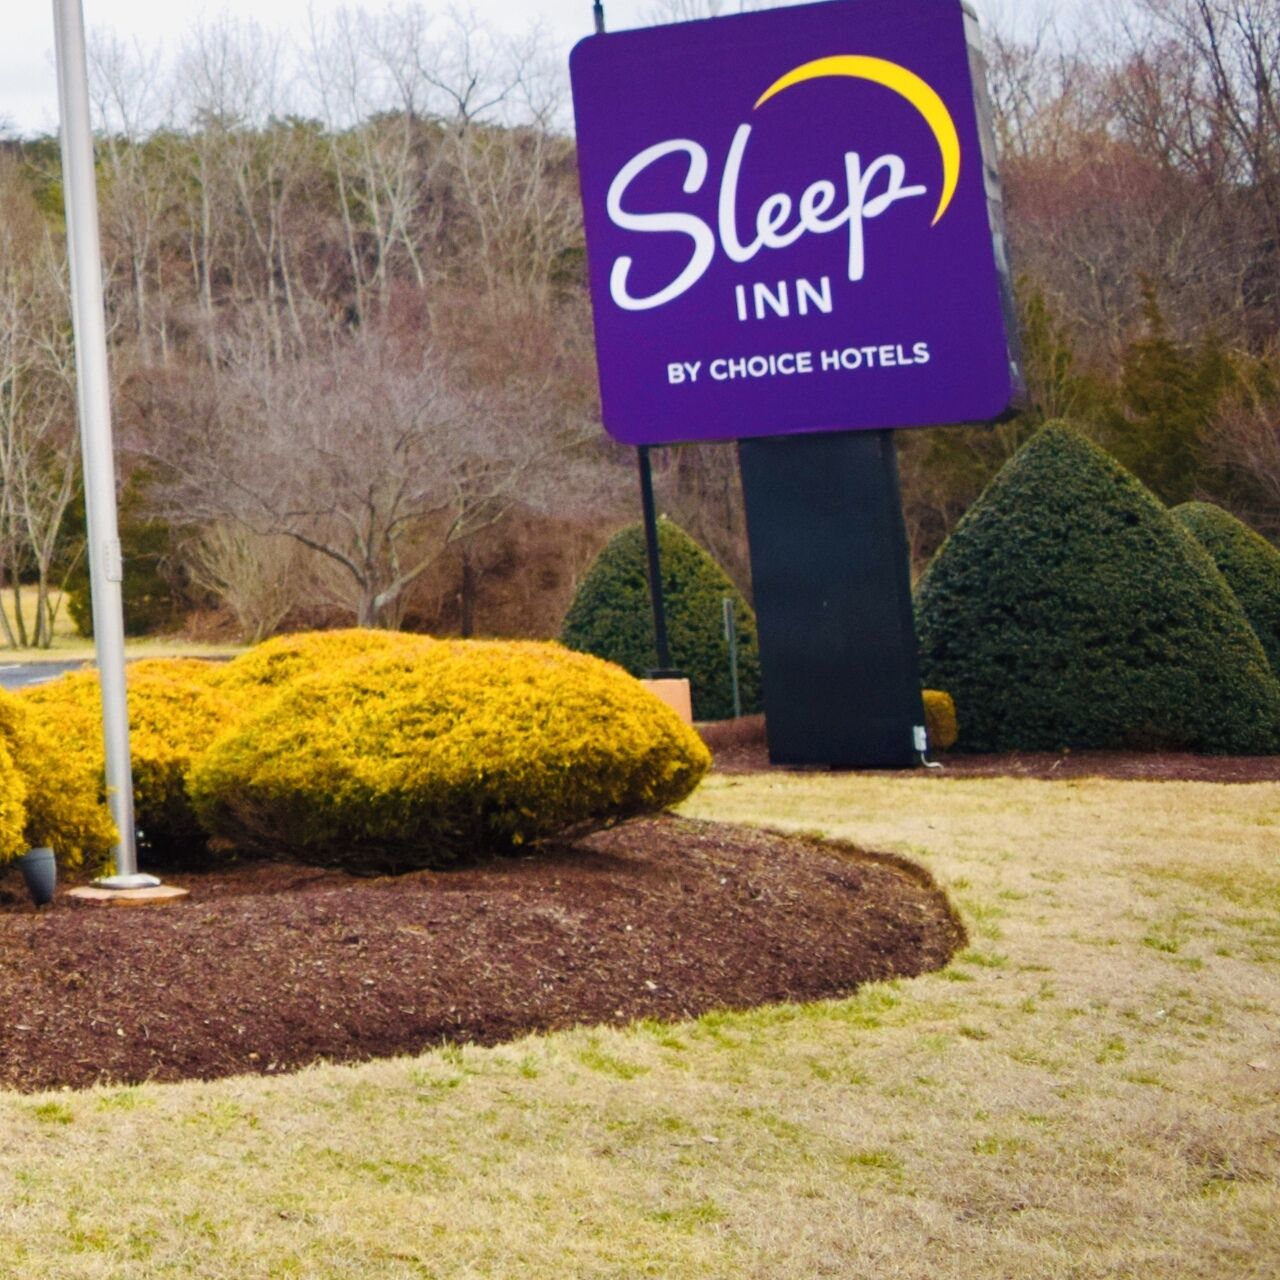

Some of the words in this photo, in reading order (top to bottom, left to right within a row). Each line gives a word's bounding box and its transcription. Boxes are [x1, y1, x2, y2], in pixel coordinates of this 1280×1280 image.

[606, 123, 927, 311] Sleep
[735, 276, 833, 322] INN
[667, 361, 702, 385] BY
[709, 352, 813, 381] CHOICE
[820, 341, 930, 371] HOTELS
